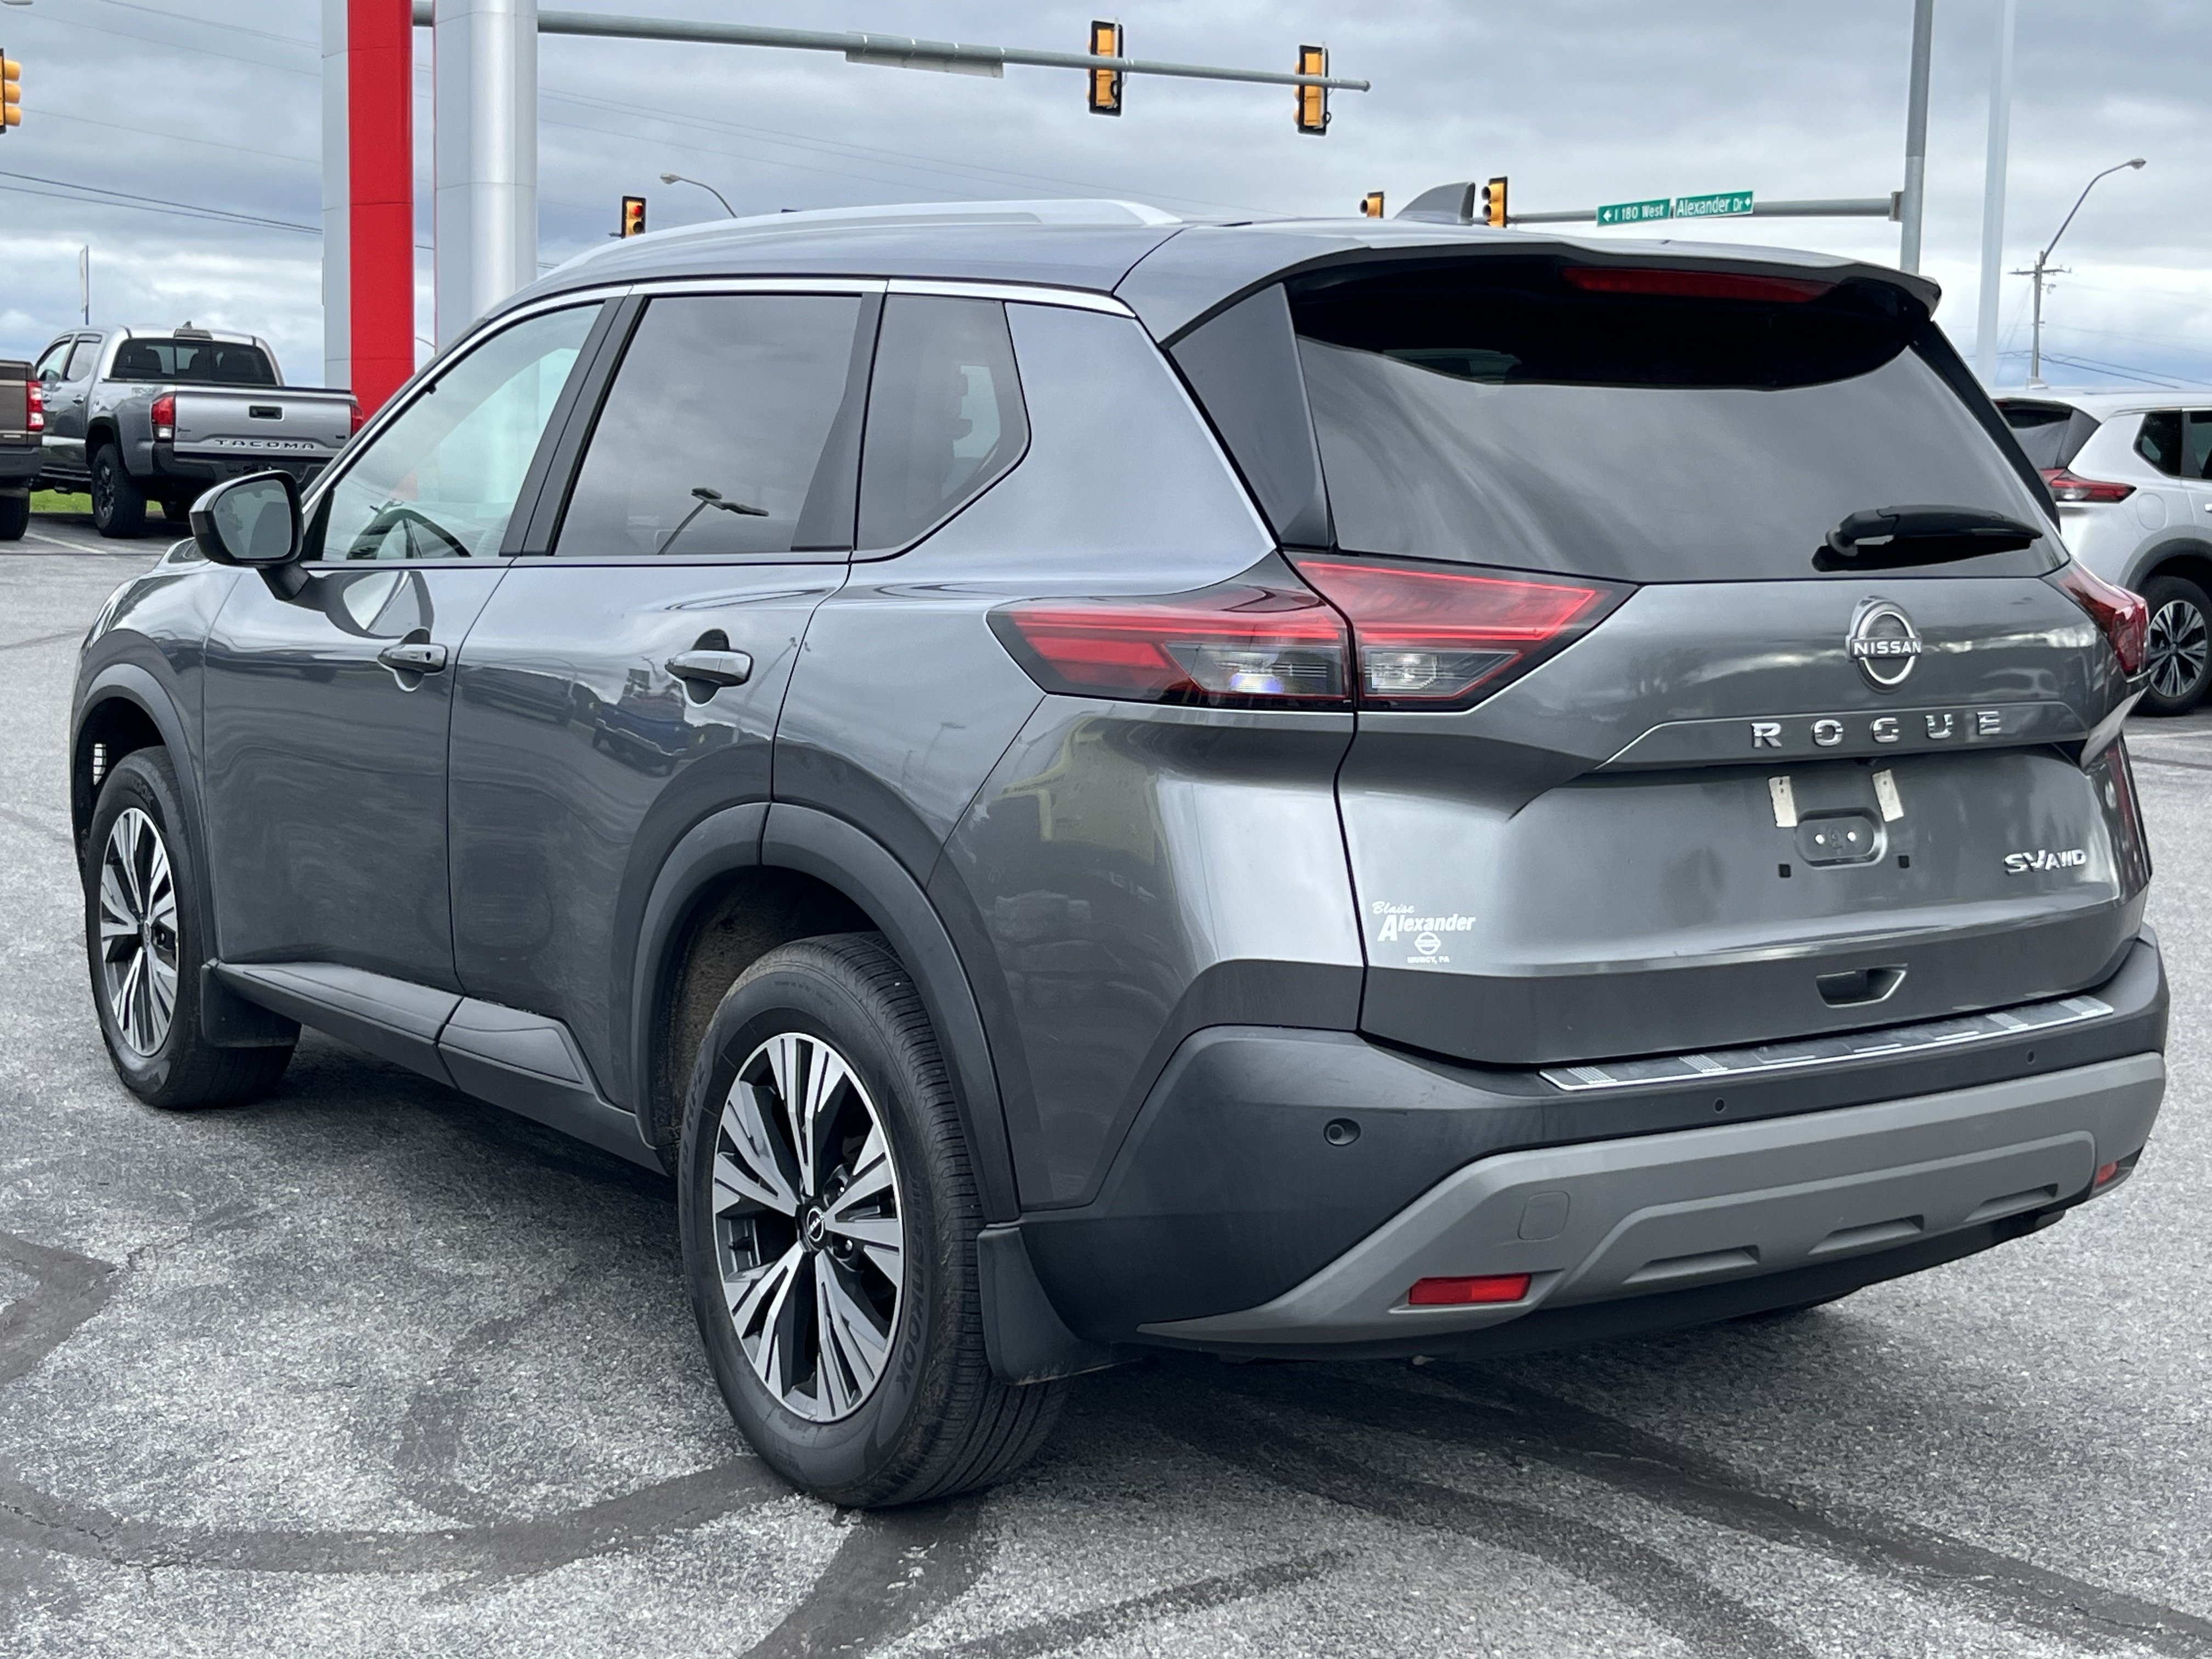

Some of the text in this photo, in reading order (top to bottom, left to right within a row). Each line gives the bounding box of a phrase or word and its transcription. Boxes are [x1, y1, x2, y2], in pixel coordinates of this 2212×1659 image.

[1622, 207, 1638, 221] 180
[1641, 205, 1664, 218] West
[1677, 198, 1743, 216] Alexander Dr
[215, 439, 314, 450] TACOMA
[1854, 640, 1922, 655] NISSAN
[1751, 710, 2002, 748] ROGUE
[1372, 900, 1415, 915] Blaise
[1377, 913, 1476, 942] Alexander
